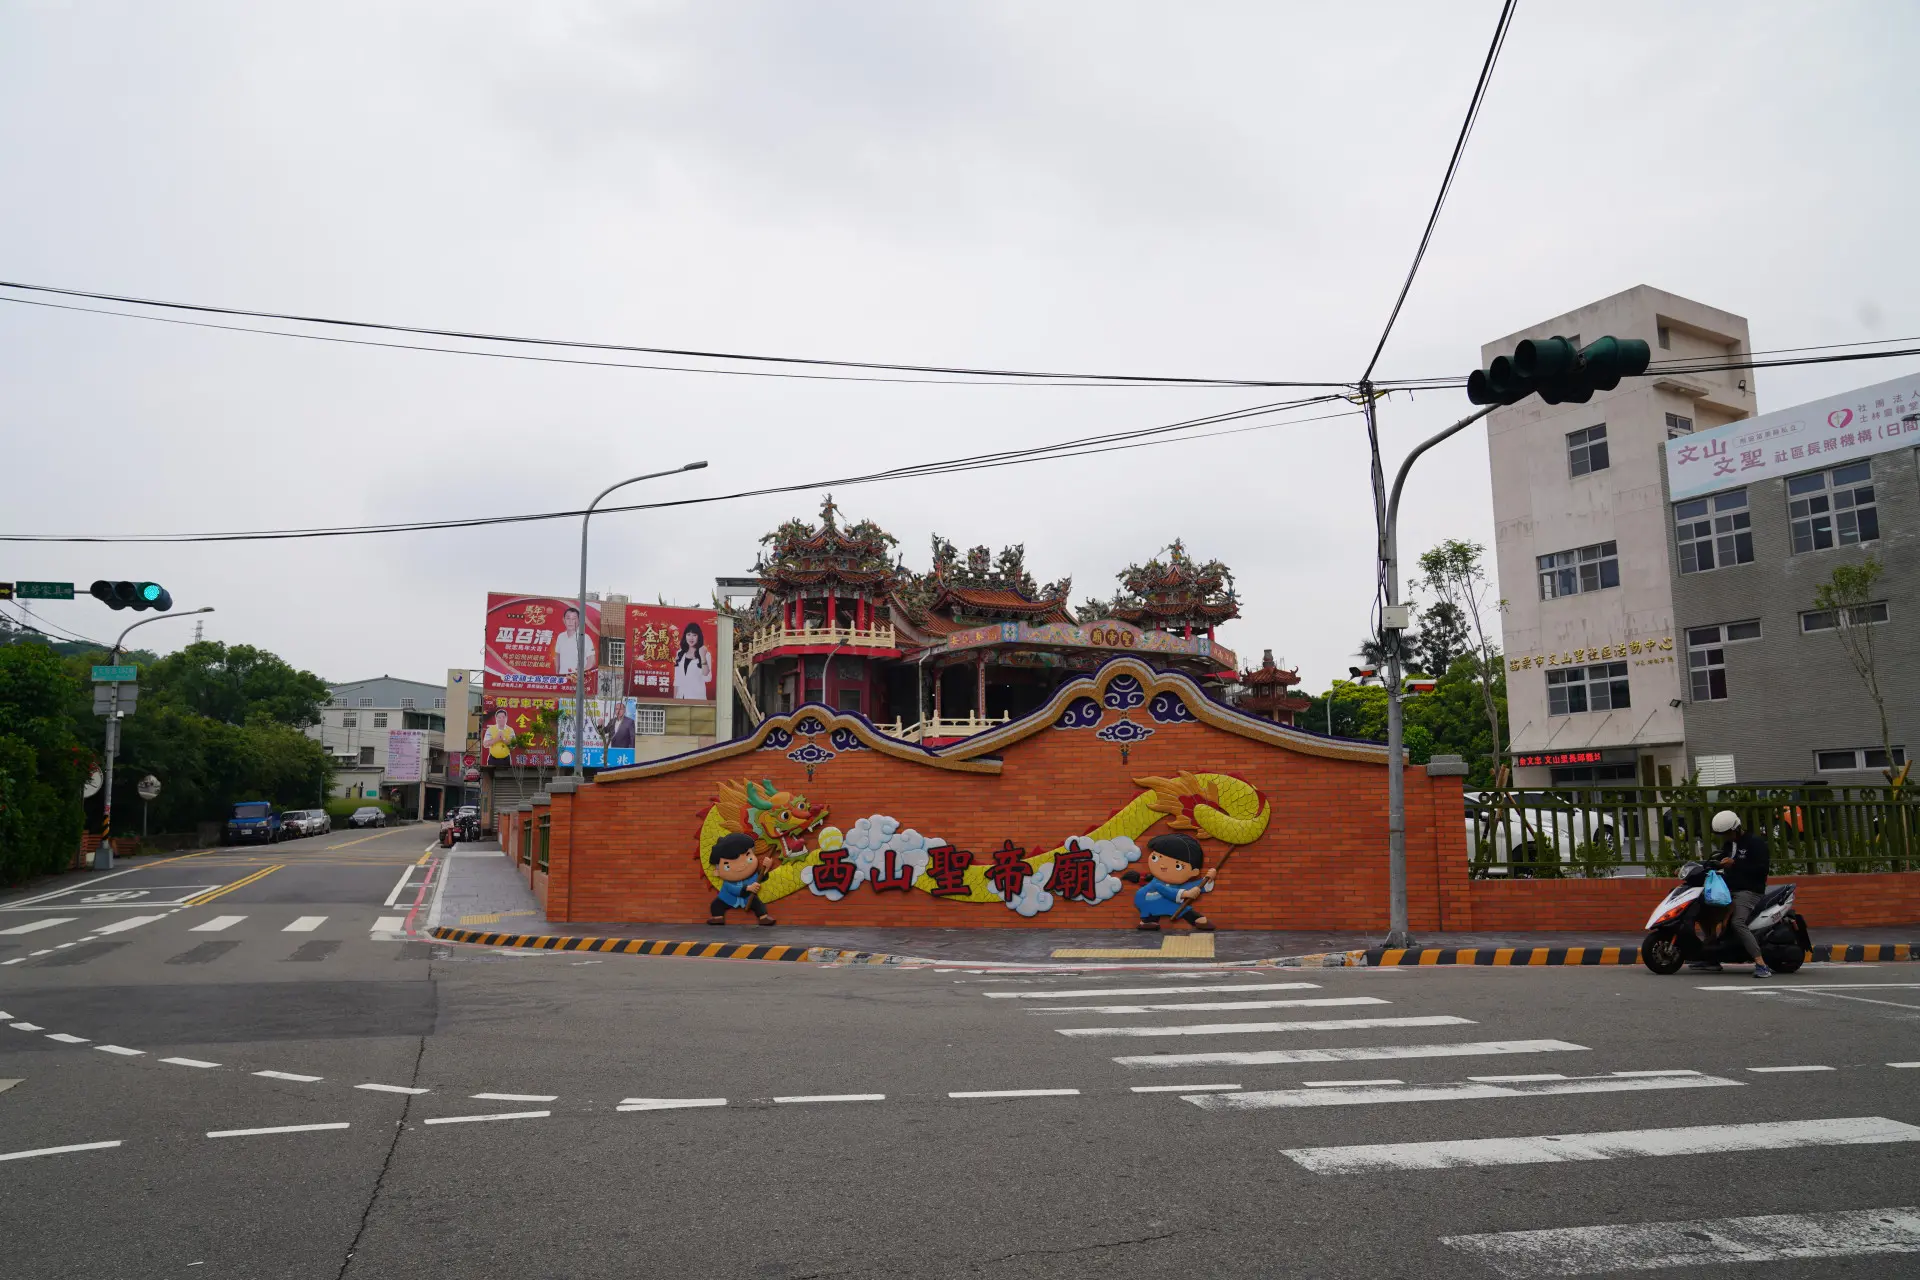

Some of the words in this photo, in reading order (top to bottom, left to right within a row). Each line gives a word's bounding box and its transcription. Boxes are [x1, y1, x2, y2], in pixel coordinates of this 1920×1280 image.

[1677, 439, 1727, 465] 文山
[1713, 448, 1766, 477] 文聖
[495, 627, 553, 645] 巫召清
[812, 839, 1097, 901] 西山聖帝廟
